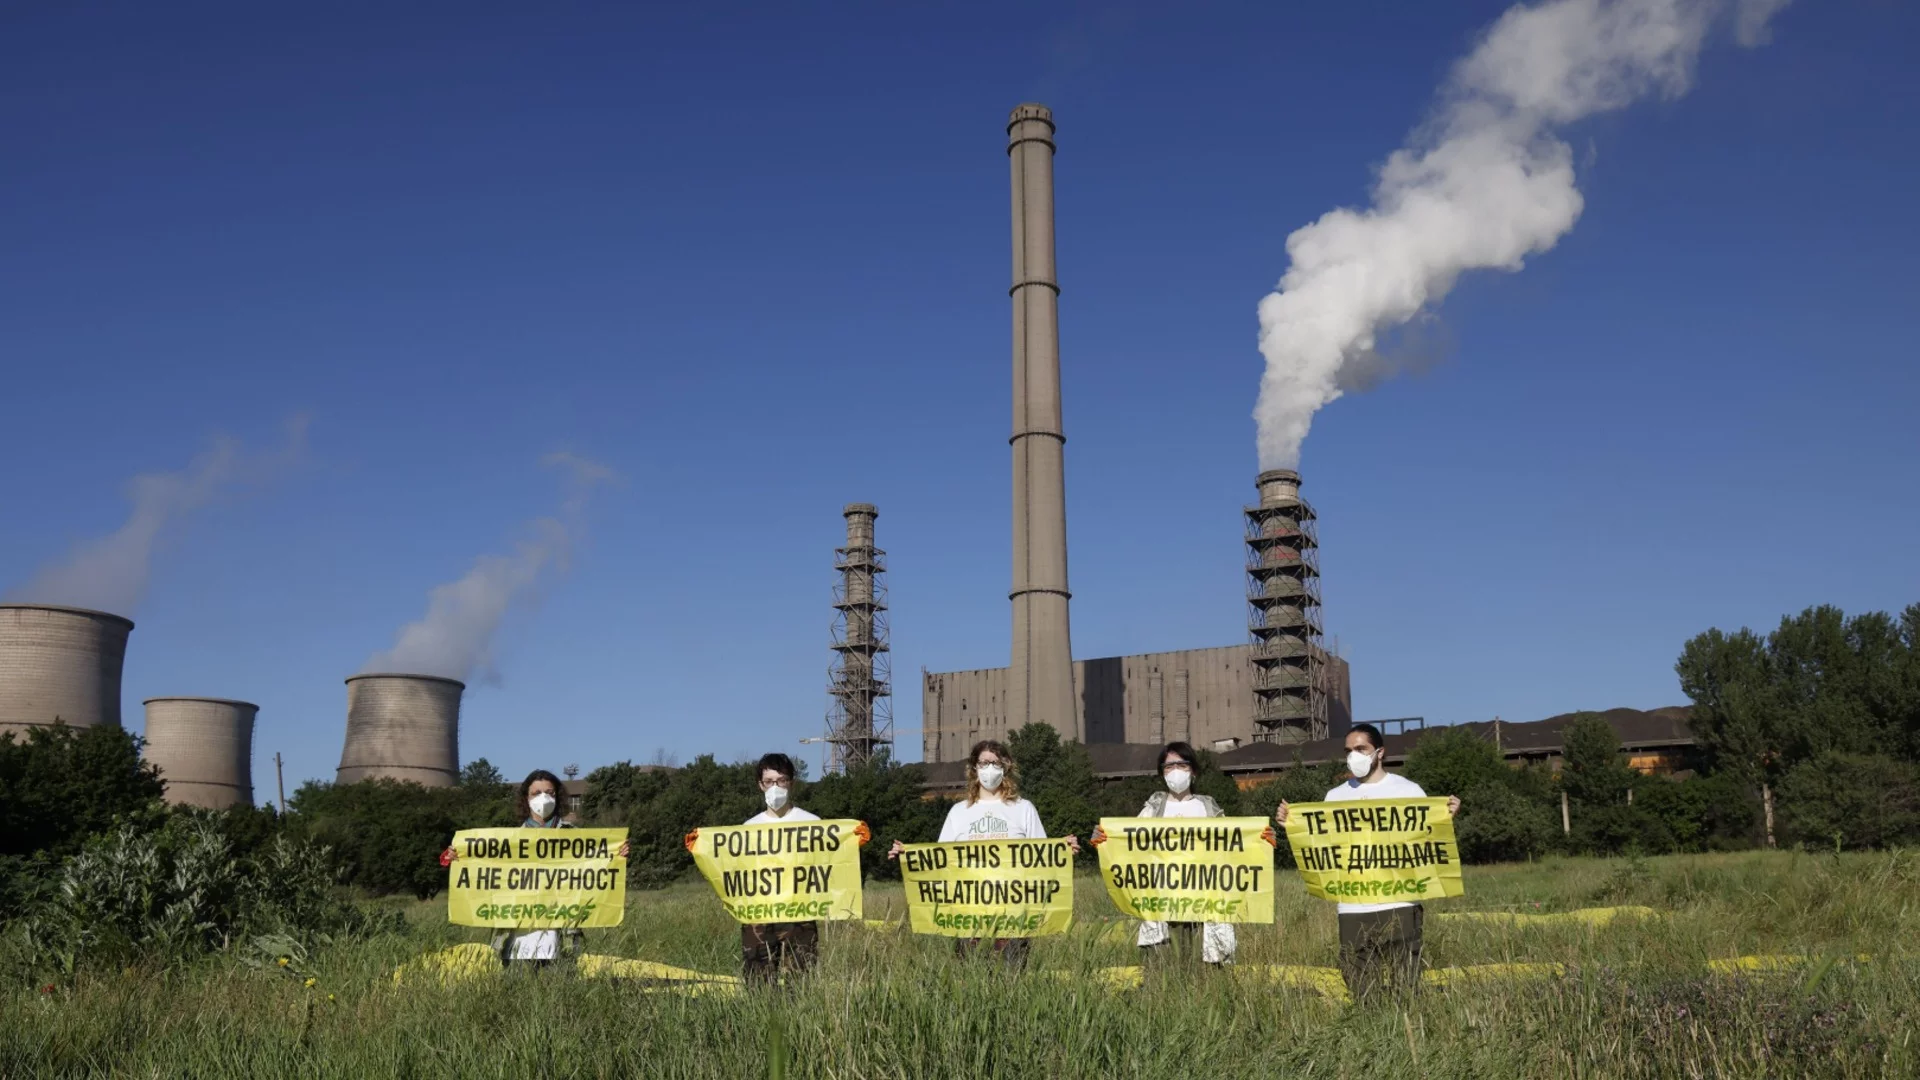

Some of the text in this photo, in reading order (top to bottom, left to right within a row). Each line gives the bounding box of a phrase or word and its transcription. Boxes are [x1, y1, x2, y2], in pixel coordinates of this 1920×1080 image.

[1302, 806, 1432, 835] ТЕ ПЕЧЕЛЯТ,
[465, 838, 614, 862] ТОВА Е ОТРОВА,
[714, 824, 840, 858] POLLUTERS
[1123, 827, 1244, 852] ТОКСИЧНА
[906, 843, 1067, 872] END THIS TOXIC
[1301, 842, 1449, 874] НИЕ ДИШАМЕ
[457, 867, 619, 890] А НЕ СИГУРНОСТ
[723, 865, 832, 897] MUST PAY
[1110, 864, 1263, 892] ЗАВИСИМОСТ
[1324, 877, 1431, 896] GREENPEACE
[919, 880, 1060, 904] RELATIONSHIP
[476, 903, 596, 920] GREENPEACE
[1131, 897, 1242, 915] GREENPEACE
